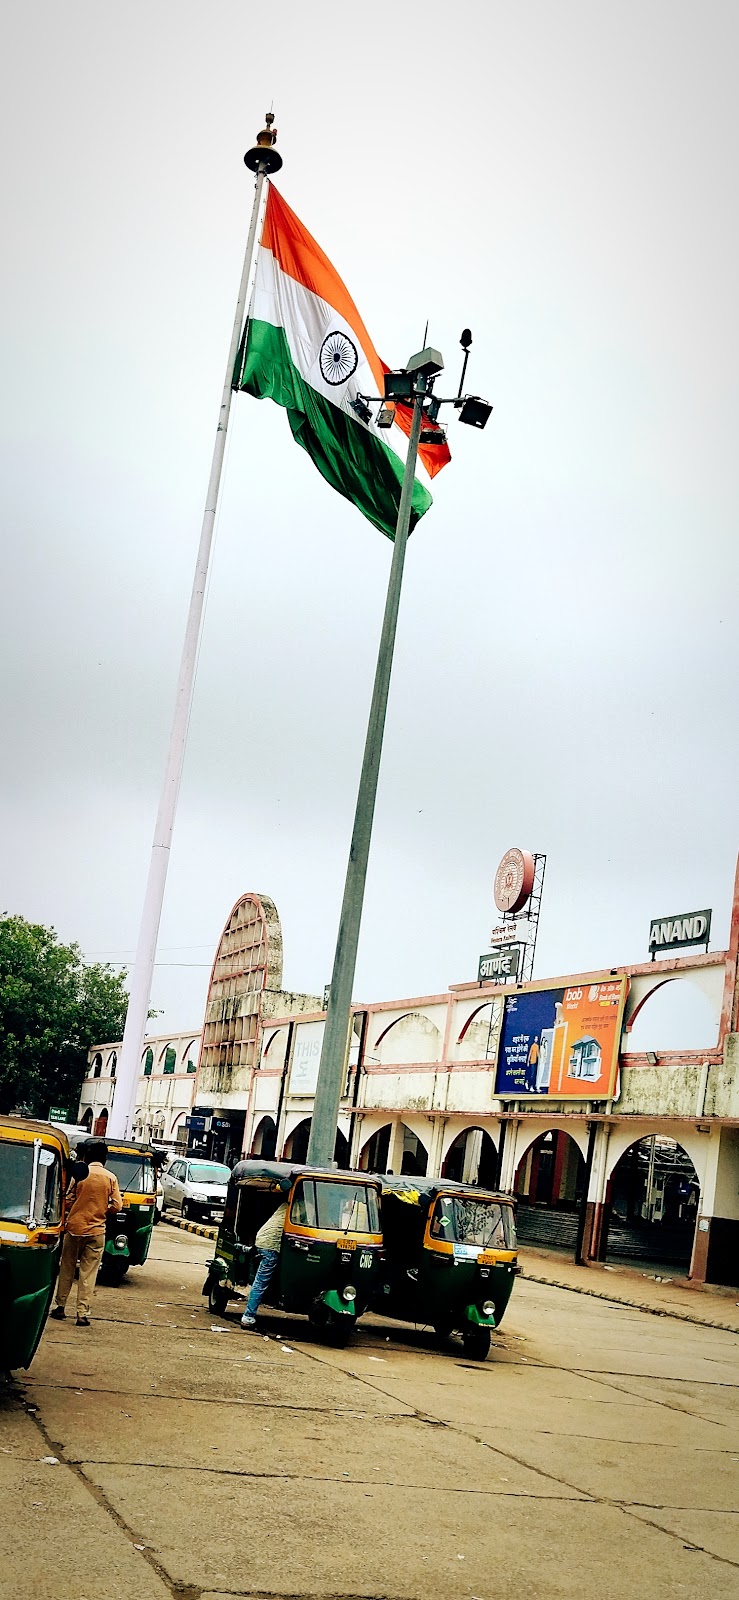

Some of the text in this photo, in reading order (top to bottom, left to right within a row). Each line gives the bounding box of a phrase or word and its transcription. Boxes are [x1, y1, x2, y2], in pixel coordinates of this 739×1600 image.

[649, 916, 707, 945] ANAND
[480, 953, 513, 977] आणंद
[566, 987, 582, 1001] bob
[360, 1254, 373, 1268] CNG
